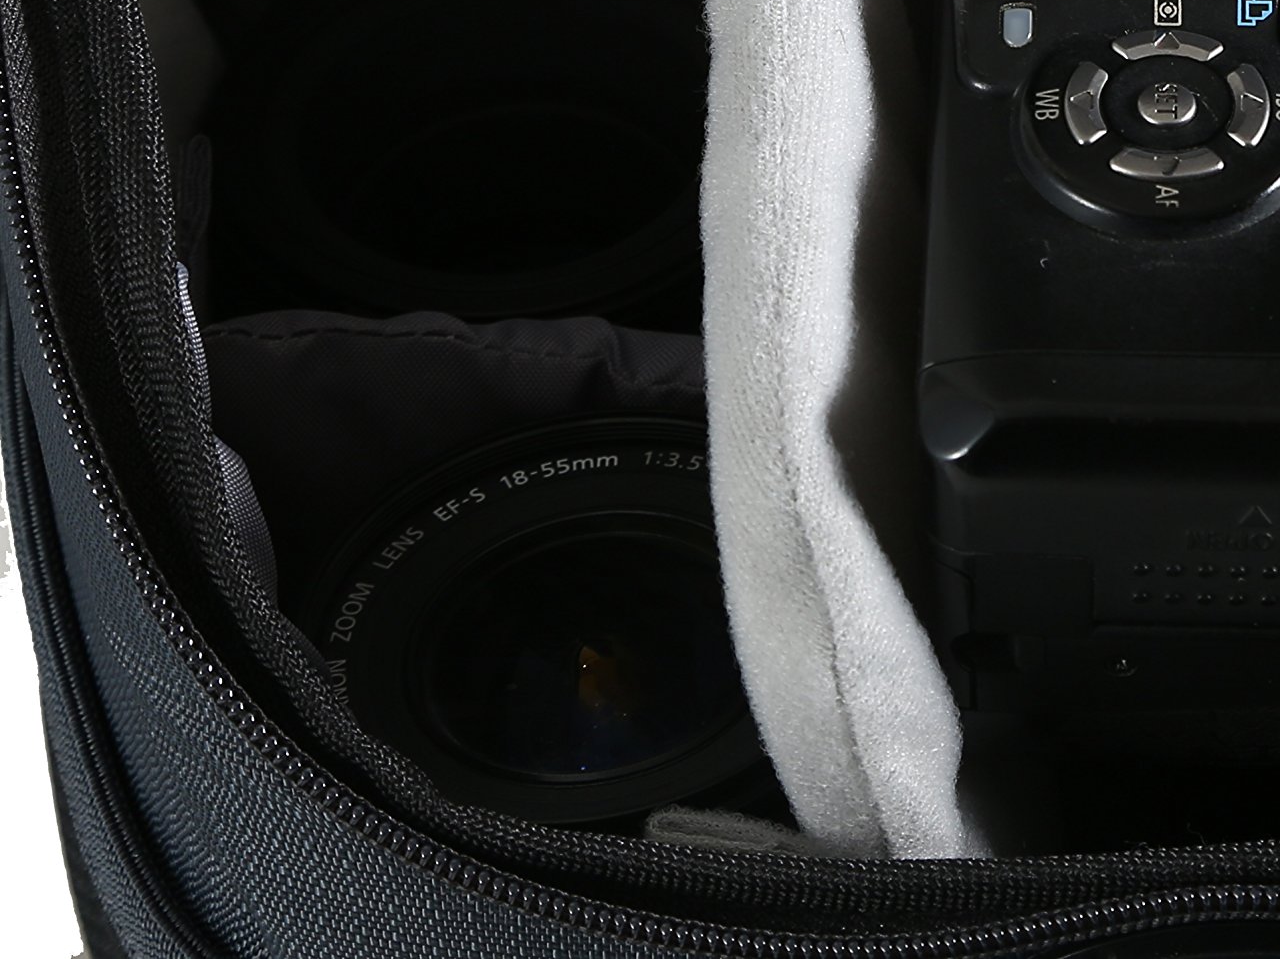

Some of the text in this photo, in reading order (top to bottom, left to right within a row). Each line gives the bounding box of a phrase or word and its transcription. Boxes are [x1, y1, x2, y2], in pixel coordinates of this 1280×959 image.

[1034, 88, 1060, 120] WB
[1155, 184, 1180, 208] AF
[330, 581, 375, 643] ZOOM
[372, 526, 425, 570] LENS
[433, 486, 486, 522] EF-S
[499, 452, 619, 490] 18-55mm
